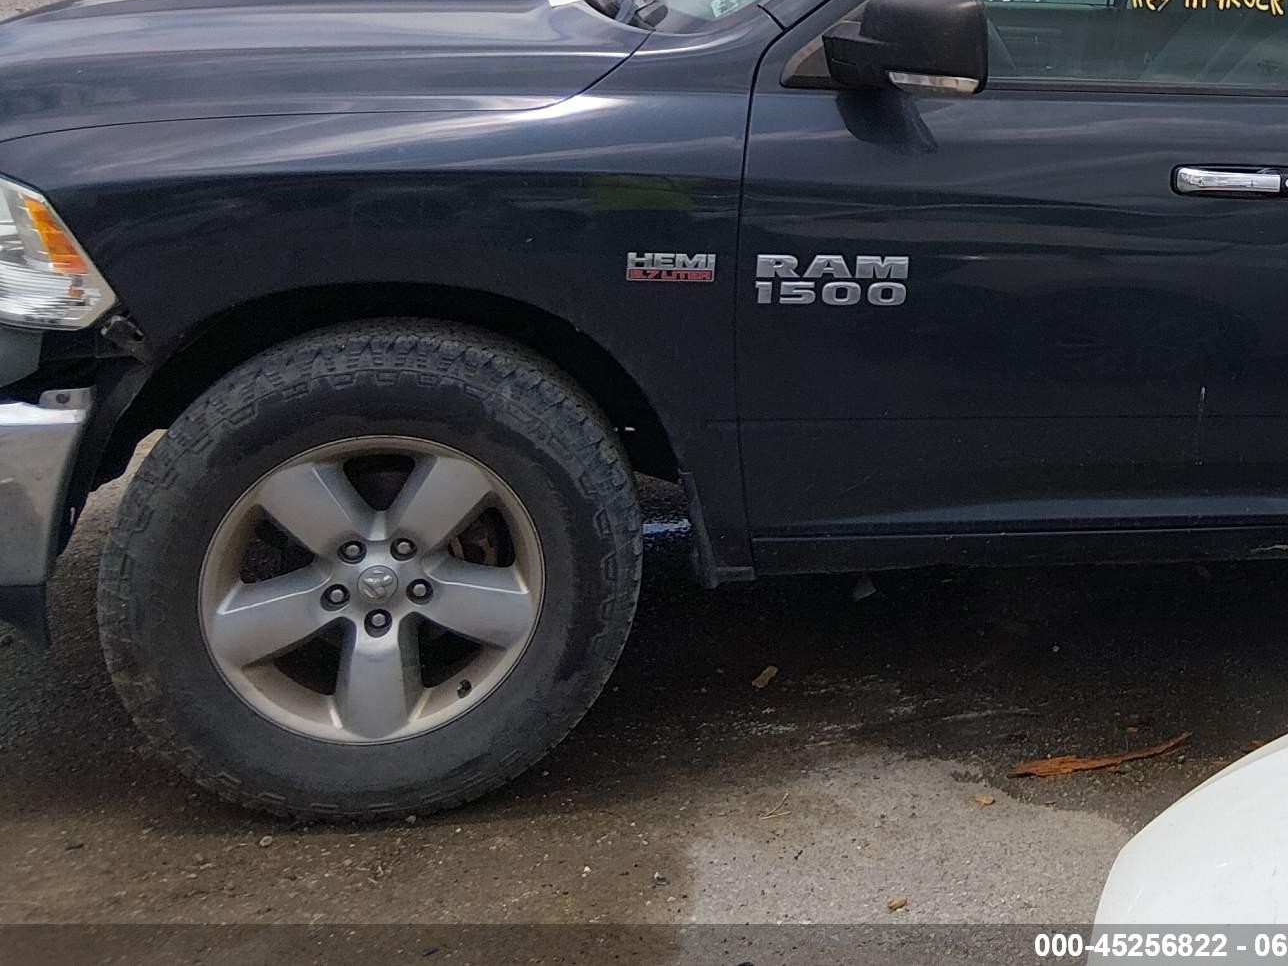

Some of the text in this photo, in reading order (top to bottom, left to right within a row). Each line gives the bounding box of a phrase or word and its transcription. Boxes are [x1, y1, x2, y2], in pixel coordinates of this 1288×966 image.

[627, 252, 717, 269] HEMI
[756, 254, 910, 279] RAM
[755, 281, 907, 306] 1500
